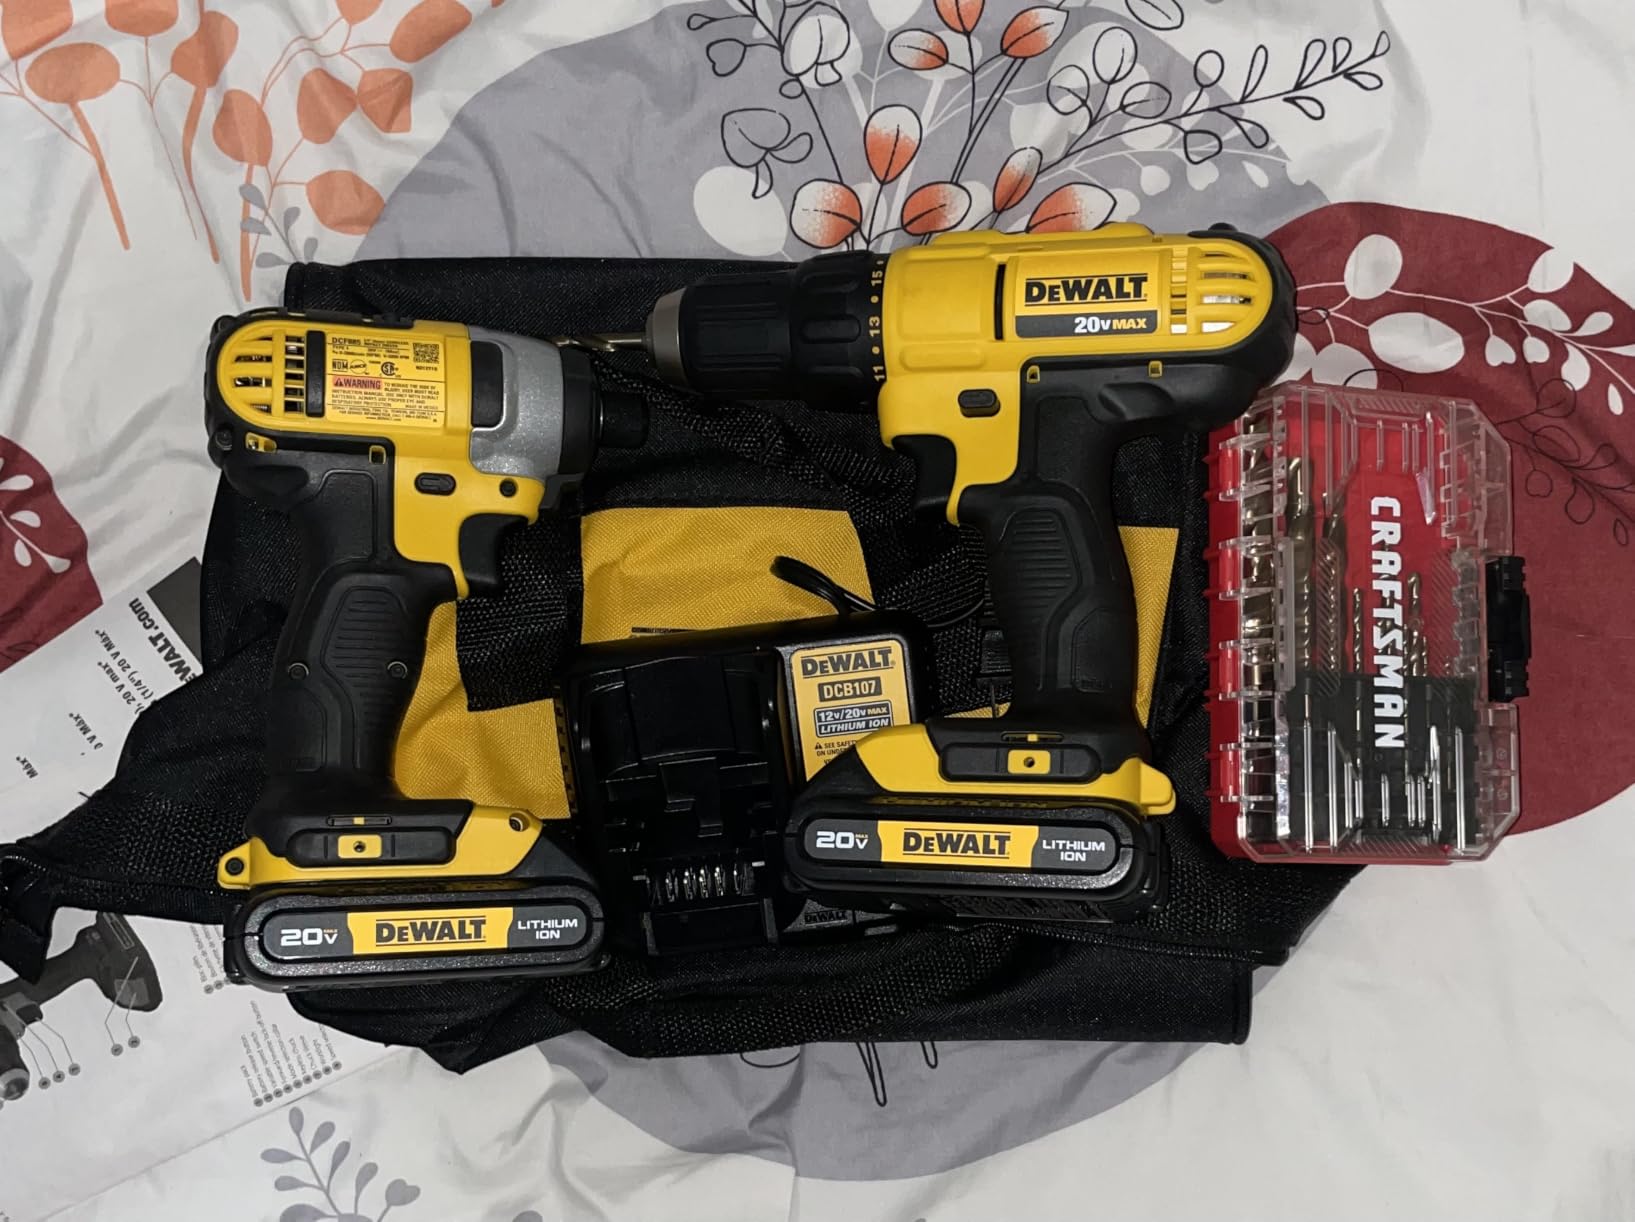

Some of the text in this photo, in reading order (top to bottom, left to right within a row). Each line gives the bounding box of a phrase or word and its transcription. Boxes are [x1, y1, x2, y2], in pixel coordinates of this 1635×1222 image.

[871, 270, 883, 286] 15
[1024, 273, 1148, 305] DEWALT
[869, 316, 880, 337] 13
[1112, 318, 1147, 330] MAX
[872, 366, 885, 381] 11
[344, 378, 381, 390] WARNING
[1370, 496, 1407, 748] CRAFTSMAN
[117, 658, 131, 672] 20
[801, 648, 893, 678] DEWALT
[823, 680, 876, 699] DCB107
[122, 691, 136, 705] 20
[867, 707, 888, 715] MAX
[821, 718, 889, 734] LITHIUM ION
[903, 828, 1011, 858] DEWALT
[1042, 839, 1105, 852] LITHIUM
[1060, 851, 1086, 861] ION
[376, 917, 486, 944] DEWALT
[517, 918, 578, 930] LITHIUM
[536, 929, 560, 940] ION
